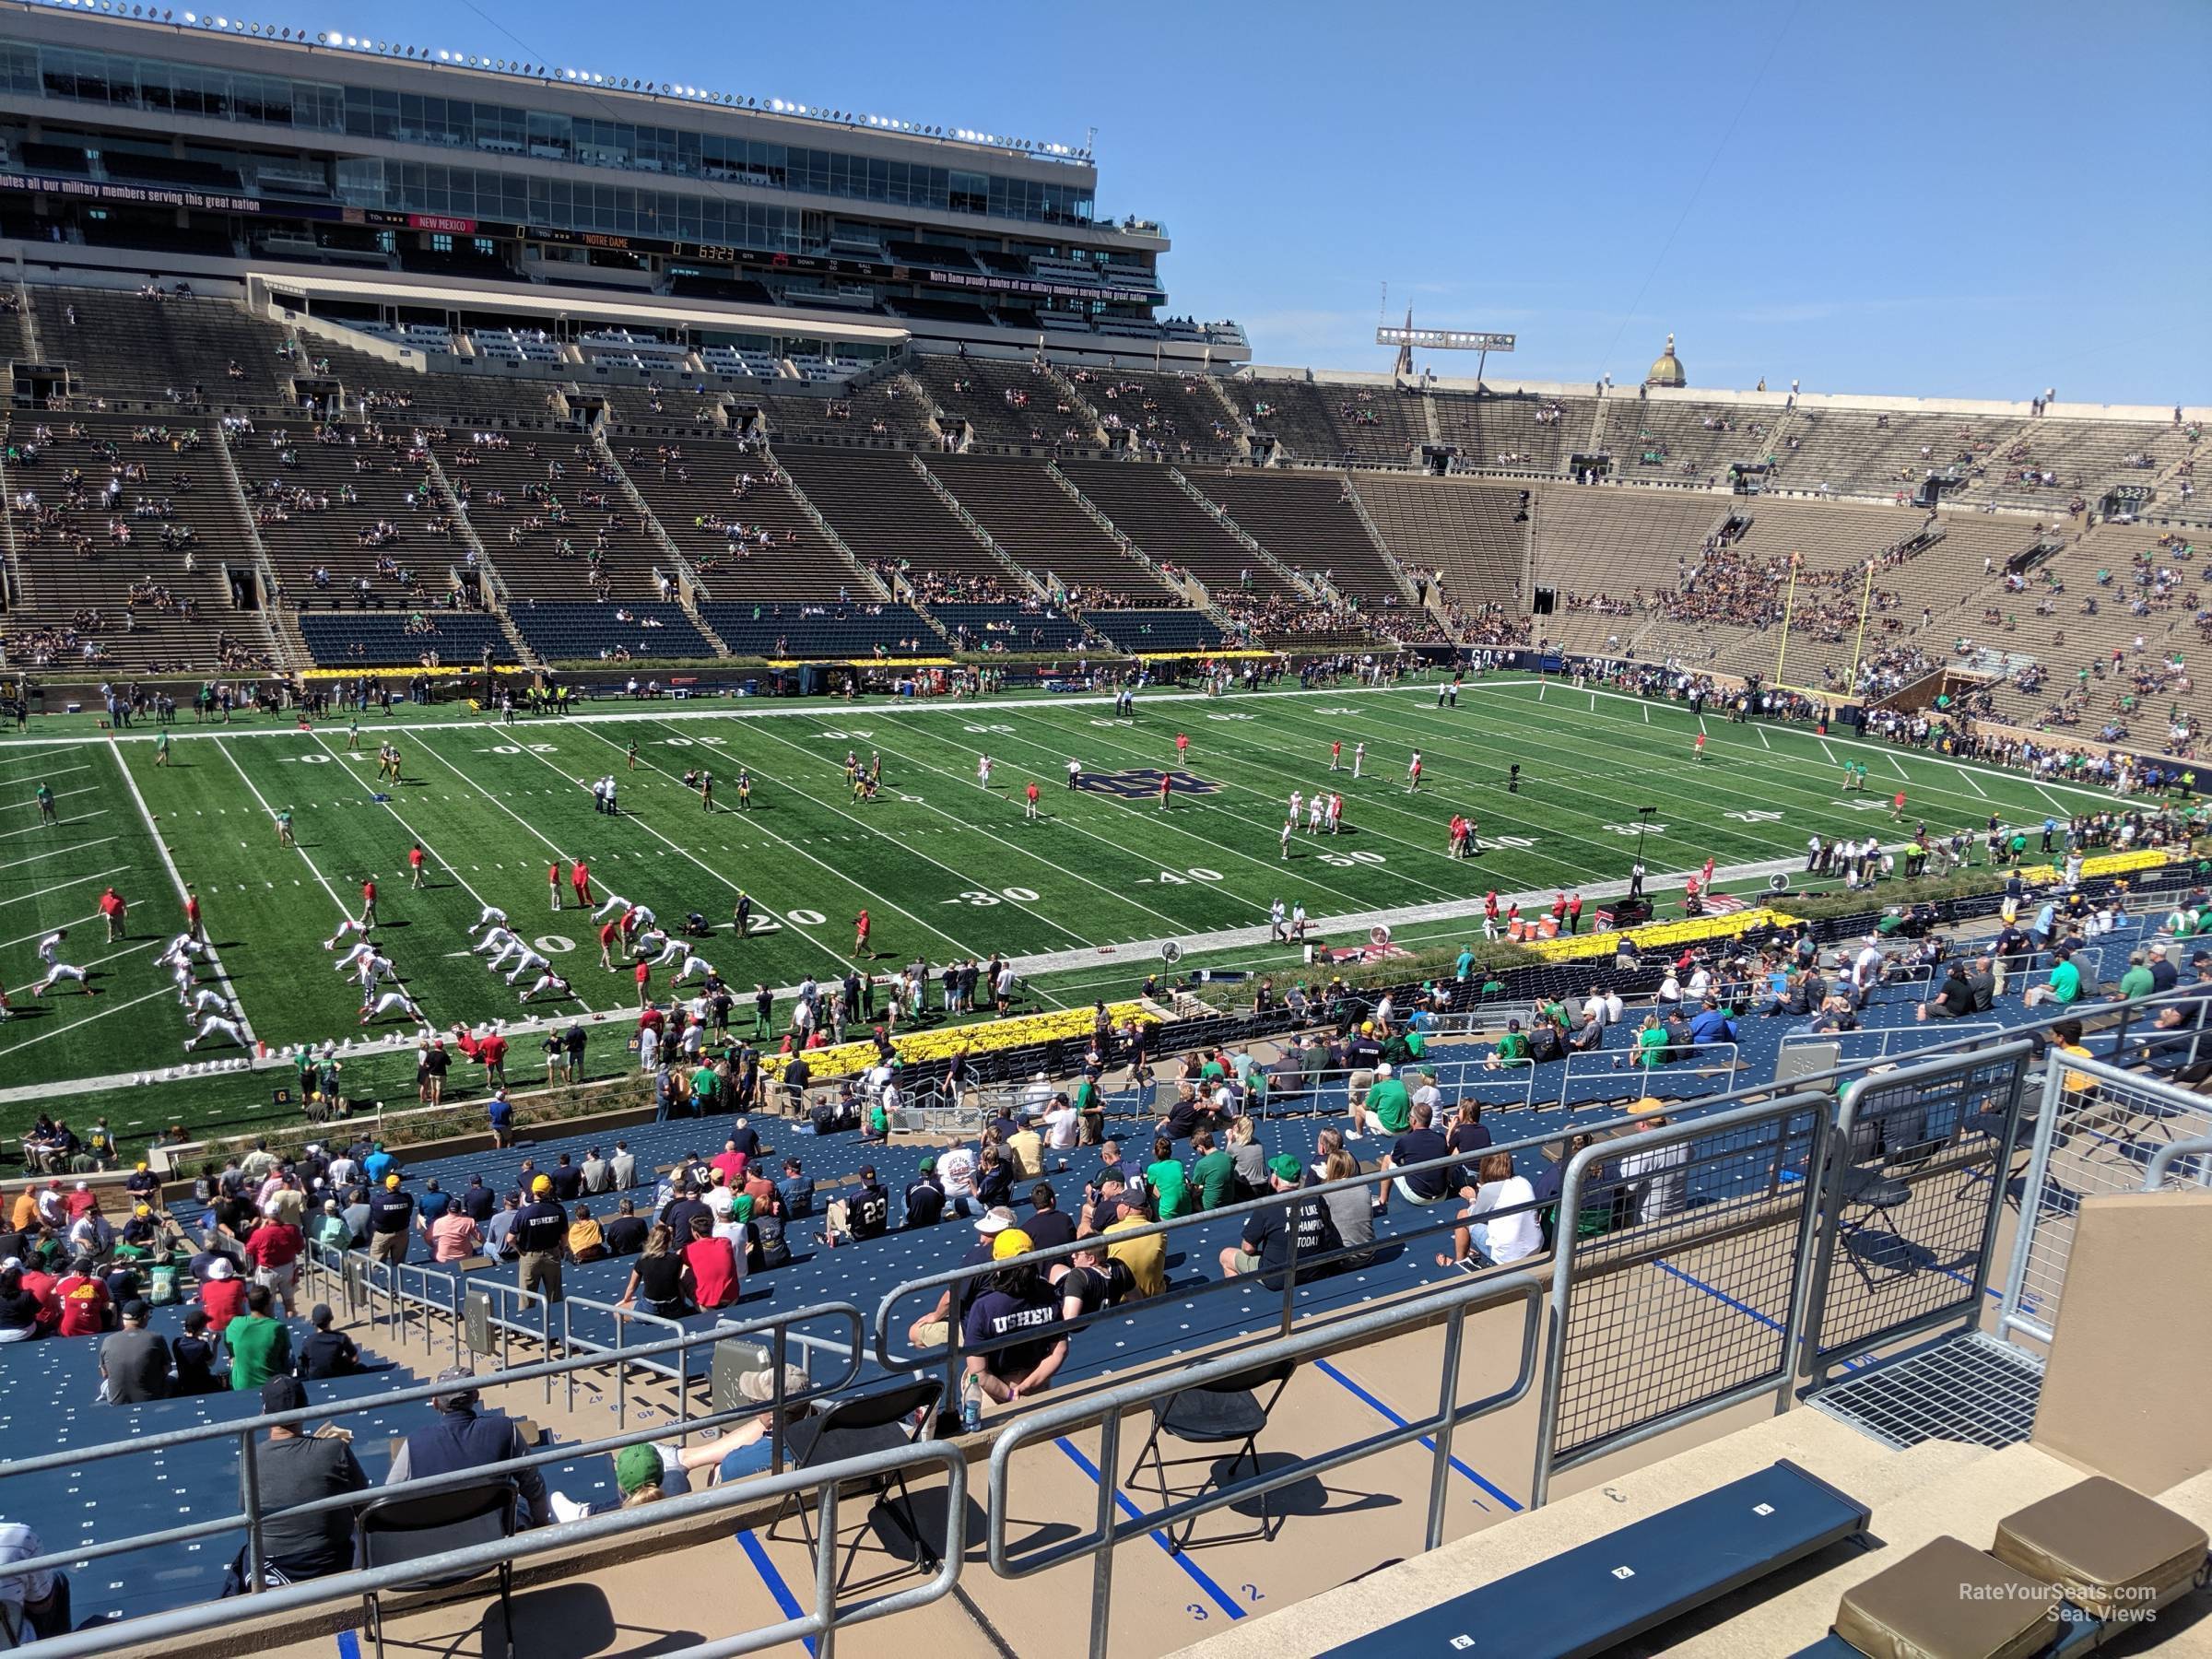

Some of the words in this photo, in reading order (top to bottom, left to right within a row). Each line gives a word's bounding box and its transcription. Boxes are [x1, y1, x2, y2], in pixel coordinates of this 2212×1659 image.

[29, 179, 40, 190] all
[43, 181, 59, 192] our
[63, 182, 100, 197] military
[102, 186, 145, 200] members
[148, 191, 183, 206] serving
[185, 194, 203, 206] this
[206, 197, 229, 208] great
[232, 199, 260, 211] nation
[419, 217, 437, 229] NEW
[438, 219, 466, 231] MEXICO
[586, 235, 608, 246] NOTRE
[609, 237, 629, 249] DAME
[699, 245, 735, 261] 63:23
[930, 271, 947, 282] Notre
[947, 273, 965, 285] Dame
[966, 276, 988, 288] proudly
[989, 278, 1010, 289] salutes
[1011, 280, 1019, 290] all
[1020, 283, 1030, 291] our
[1030, 282, 1053, 298] military
[1053, 285, 1078, 296] members
[1079, 288, 1100, 300] serving
[1101, 289, 1113, 299] this
[1113, 291, 1129, 301] great
[1129, 293, 1147, 303] nation
[2117, 487, 2148, 499] 63:23
[1601, 821, 1665, 836] 30
[1315, 851, 1386, 867] 50
[1159, 867, 1224, 885] 40
[959, 887, 1041, 906] 30
[746, 909, 829, 933] 20
[629, 1038, 640, 1050] 10
[278, 1090, 287, 1101] G
[691, 1167, 710, 1185] 12
[382, 1202, 409, 1211] USHER
[863, 1198, 887, 1225] 23
[1305, 1204, 1319, 1217] LIKE
[529, 1215, 560, 1227] USHER
[1297, 1235, 1319, 1248] TODAY
[993, 1306, 1054, 1335] USHER
[700, 1429, 718, 1440] 51
[1616, 1569, 1630, 1577] 2
[1241, 1583, 1266, 1602] 2
[1185, 1603, 1209, 1621] 3
[1455, 1638, 1469, 1647] 3
